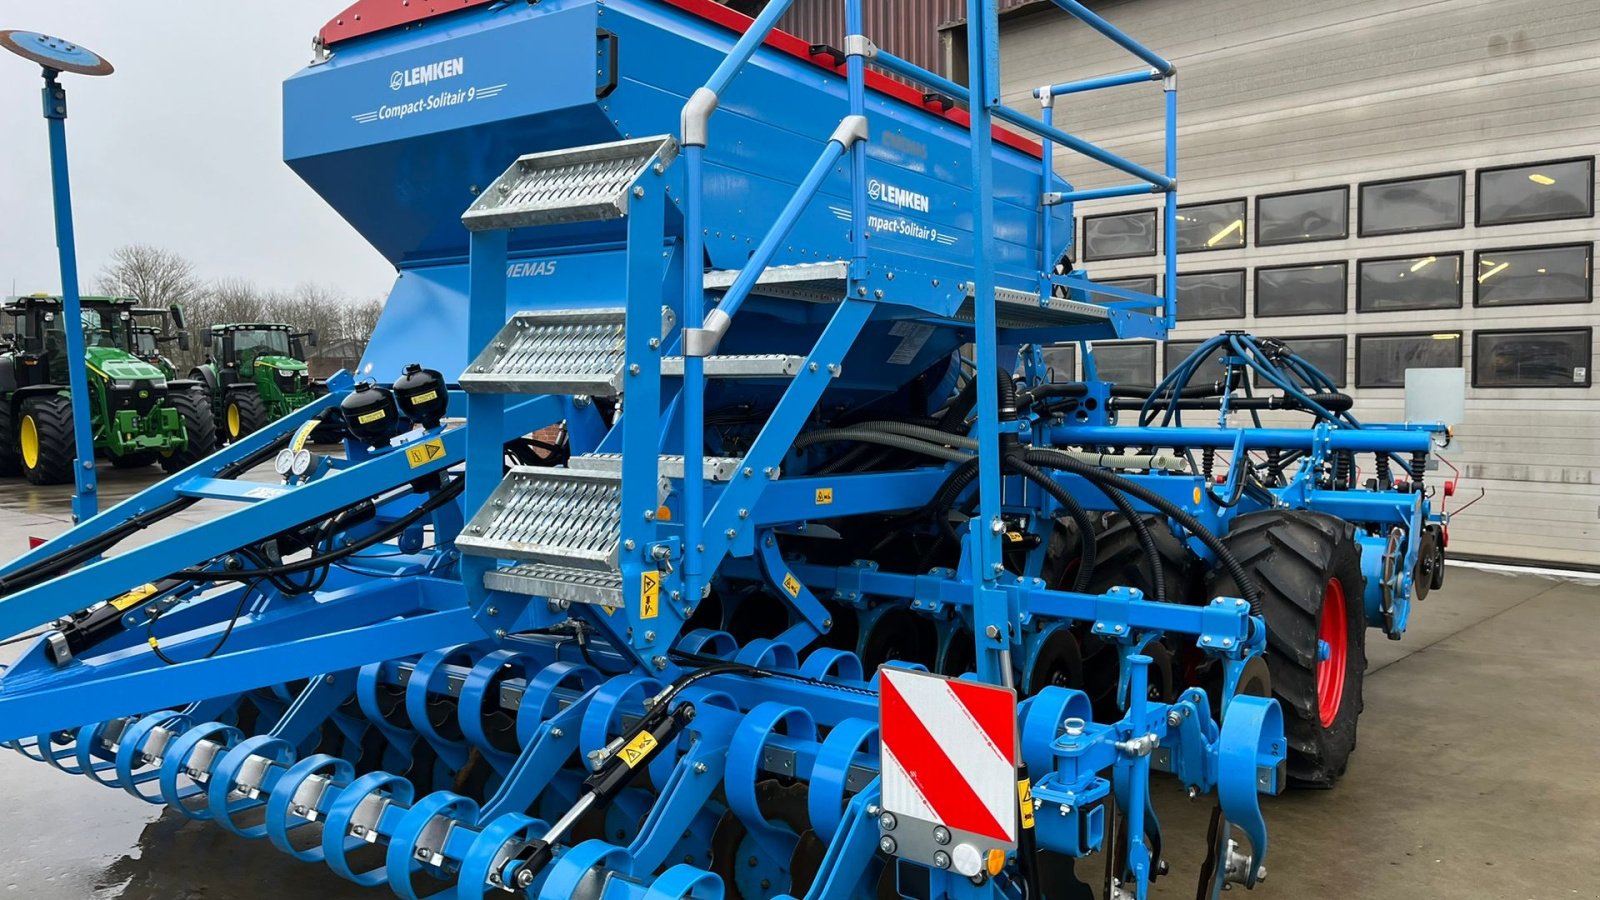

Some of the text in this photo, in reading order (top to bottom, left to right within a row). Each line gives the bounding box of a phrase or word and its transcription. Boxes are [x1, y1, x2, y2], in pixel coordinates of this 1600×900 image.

[404, 57, 464, 87] LEMKEN
[379, 87, 476, 120] Compact-Solitair 9
[881, 183, 929, 213] LEMKEN
[868, 216, 937, 242] mpact-Solitair 9
